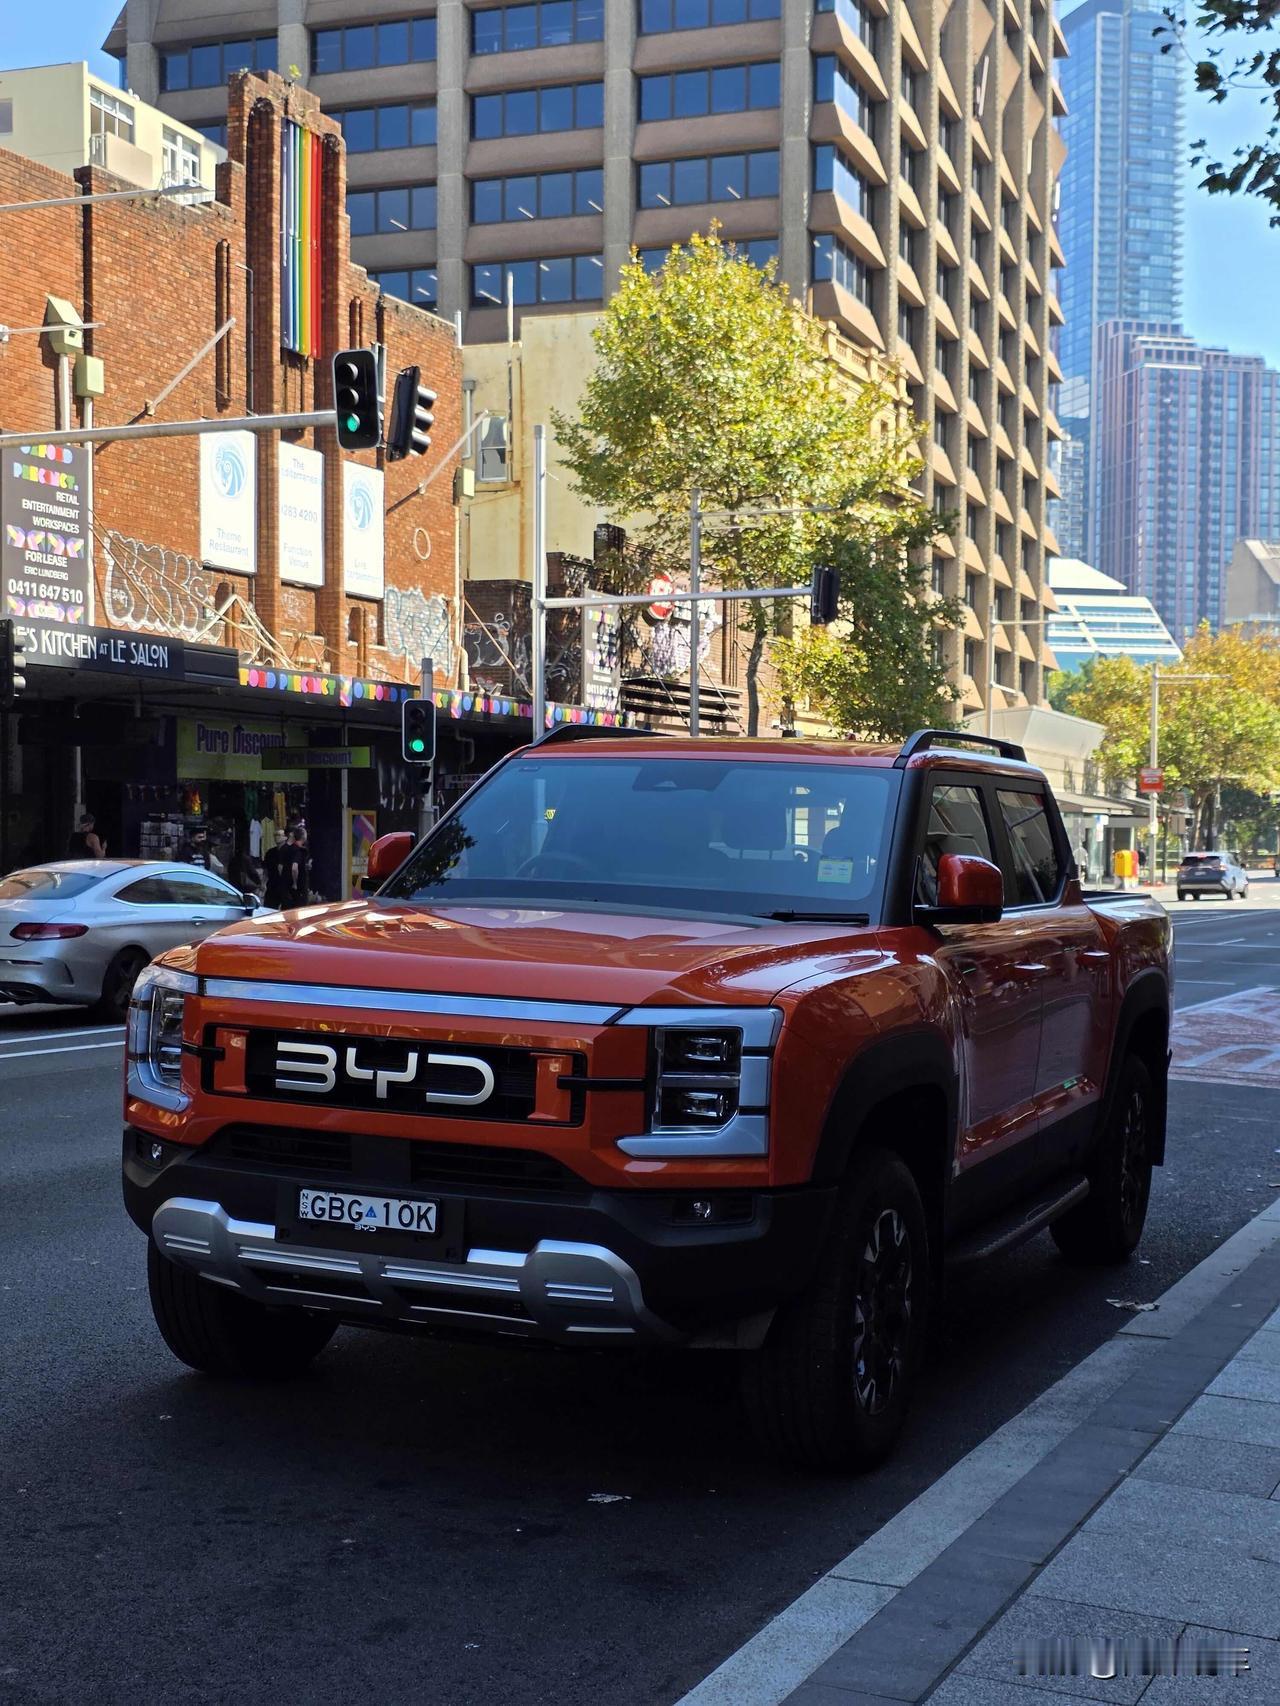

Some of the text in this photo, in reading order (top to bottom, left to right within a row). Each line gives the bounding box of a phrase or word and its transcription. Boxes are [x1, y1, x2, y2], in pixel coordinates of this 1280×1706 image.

[21, 498, 80, 520] ENTERTAINMENT
[56, 491, 80, 505] RETAIL
[32, 515, 80, 534] WORKSPACES
[25, 550, 68, 568] FOR LEASE
[8, 578, 84, 604] 0411 647 510
[41, 629, 97, 660] KITCHEN
[100, 643, 108, 655] AT
[110, 638, 127, 664] LE
[130, 641, 169, 669] SALON
[196, 722, 230, 754] Pure
[275, 1041, 495, 1106] BYD
[311, 1195, 363, 1223] GBG
[383, 1201, 433, 1231] 10K
